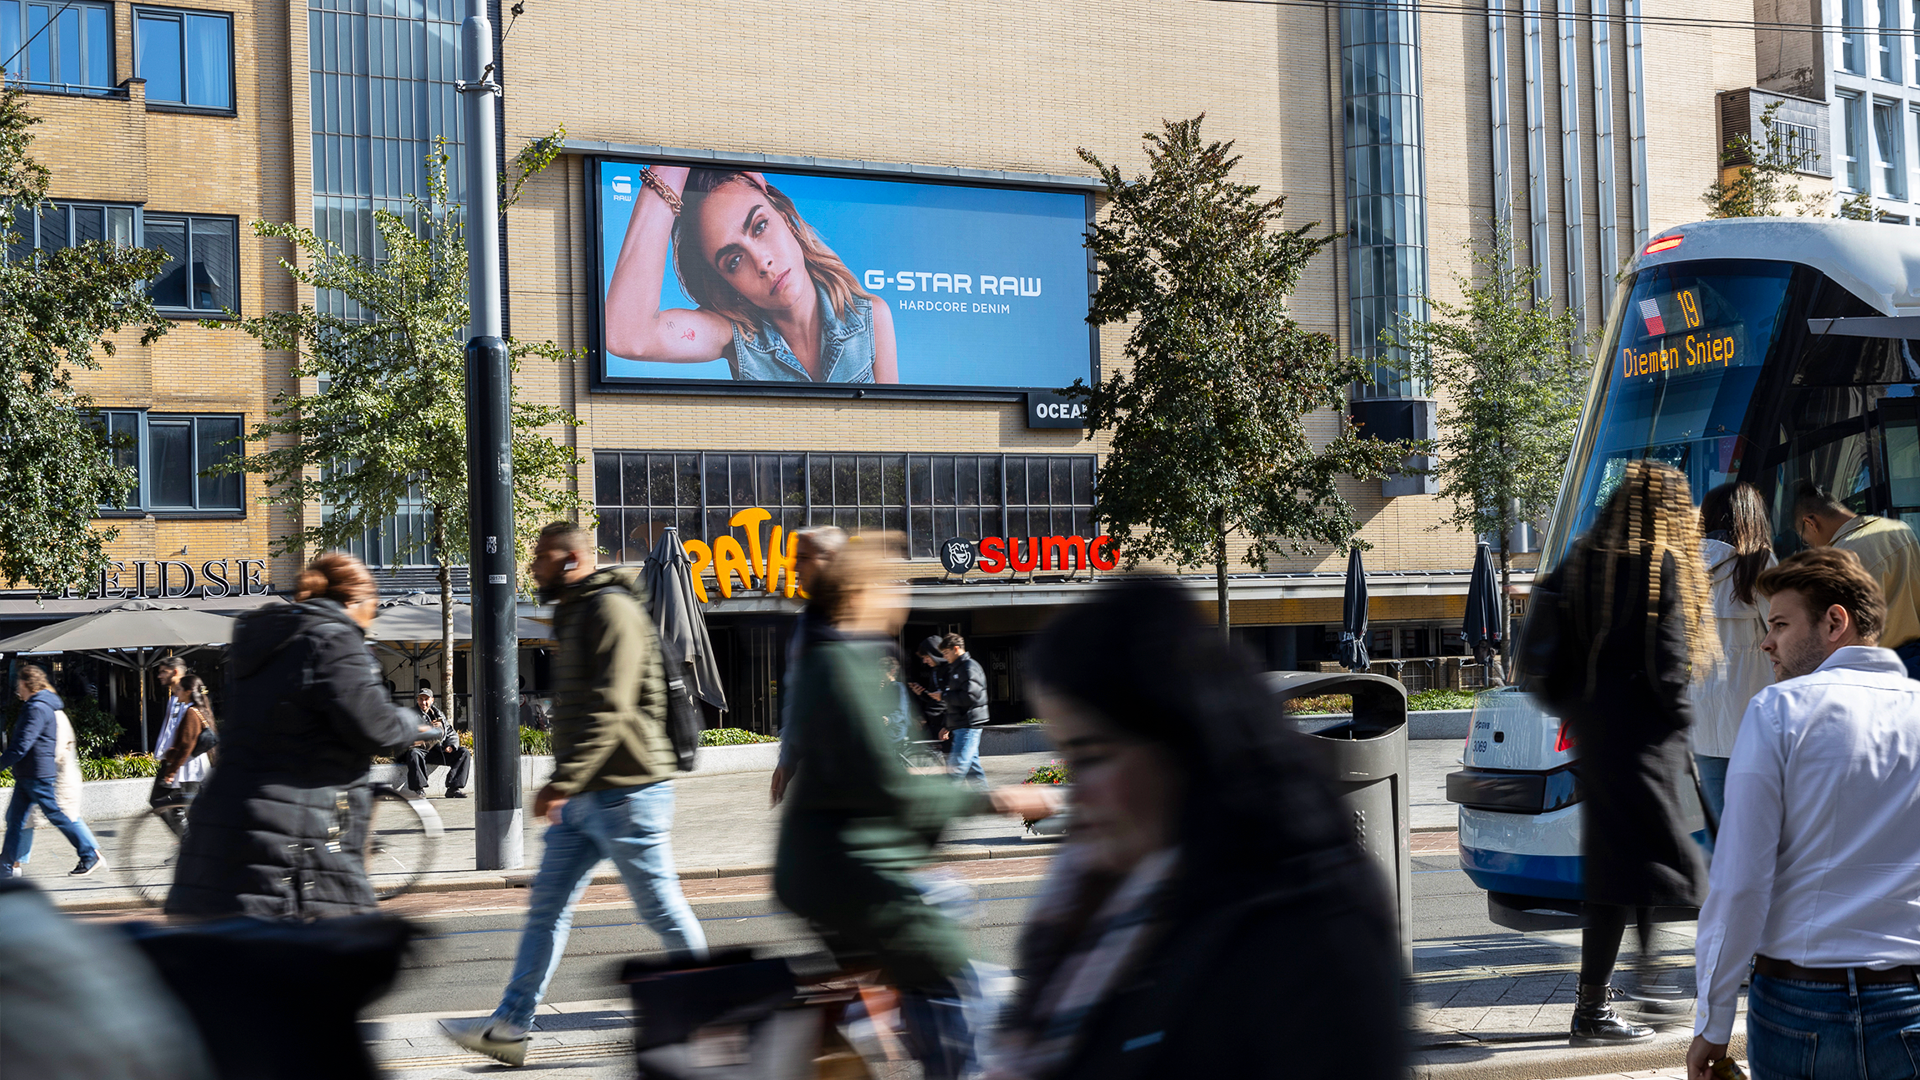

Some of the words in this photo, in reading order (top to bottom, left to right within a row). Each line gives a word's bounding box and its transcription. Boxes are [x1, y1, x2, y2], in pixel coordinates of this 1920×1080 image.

[613, 194, 632, 202] RAW
[864, 269, 973, 294] G-STAR
[980, 274, 1042, 297] RAW
[899, 300, 967, 313] HARDCORE
[972, 303, 1010, 314] DENIM
[1677, 290, 1700, 328] 19
[1623, 347, 1679, 378] Diemen
[1685, 333, 1734, 367] Sniep
[682, 507, 813, 604] PATH
[1472, 740, 1488, 753] 3069
